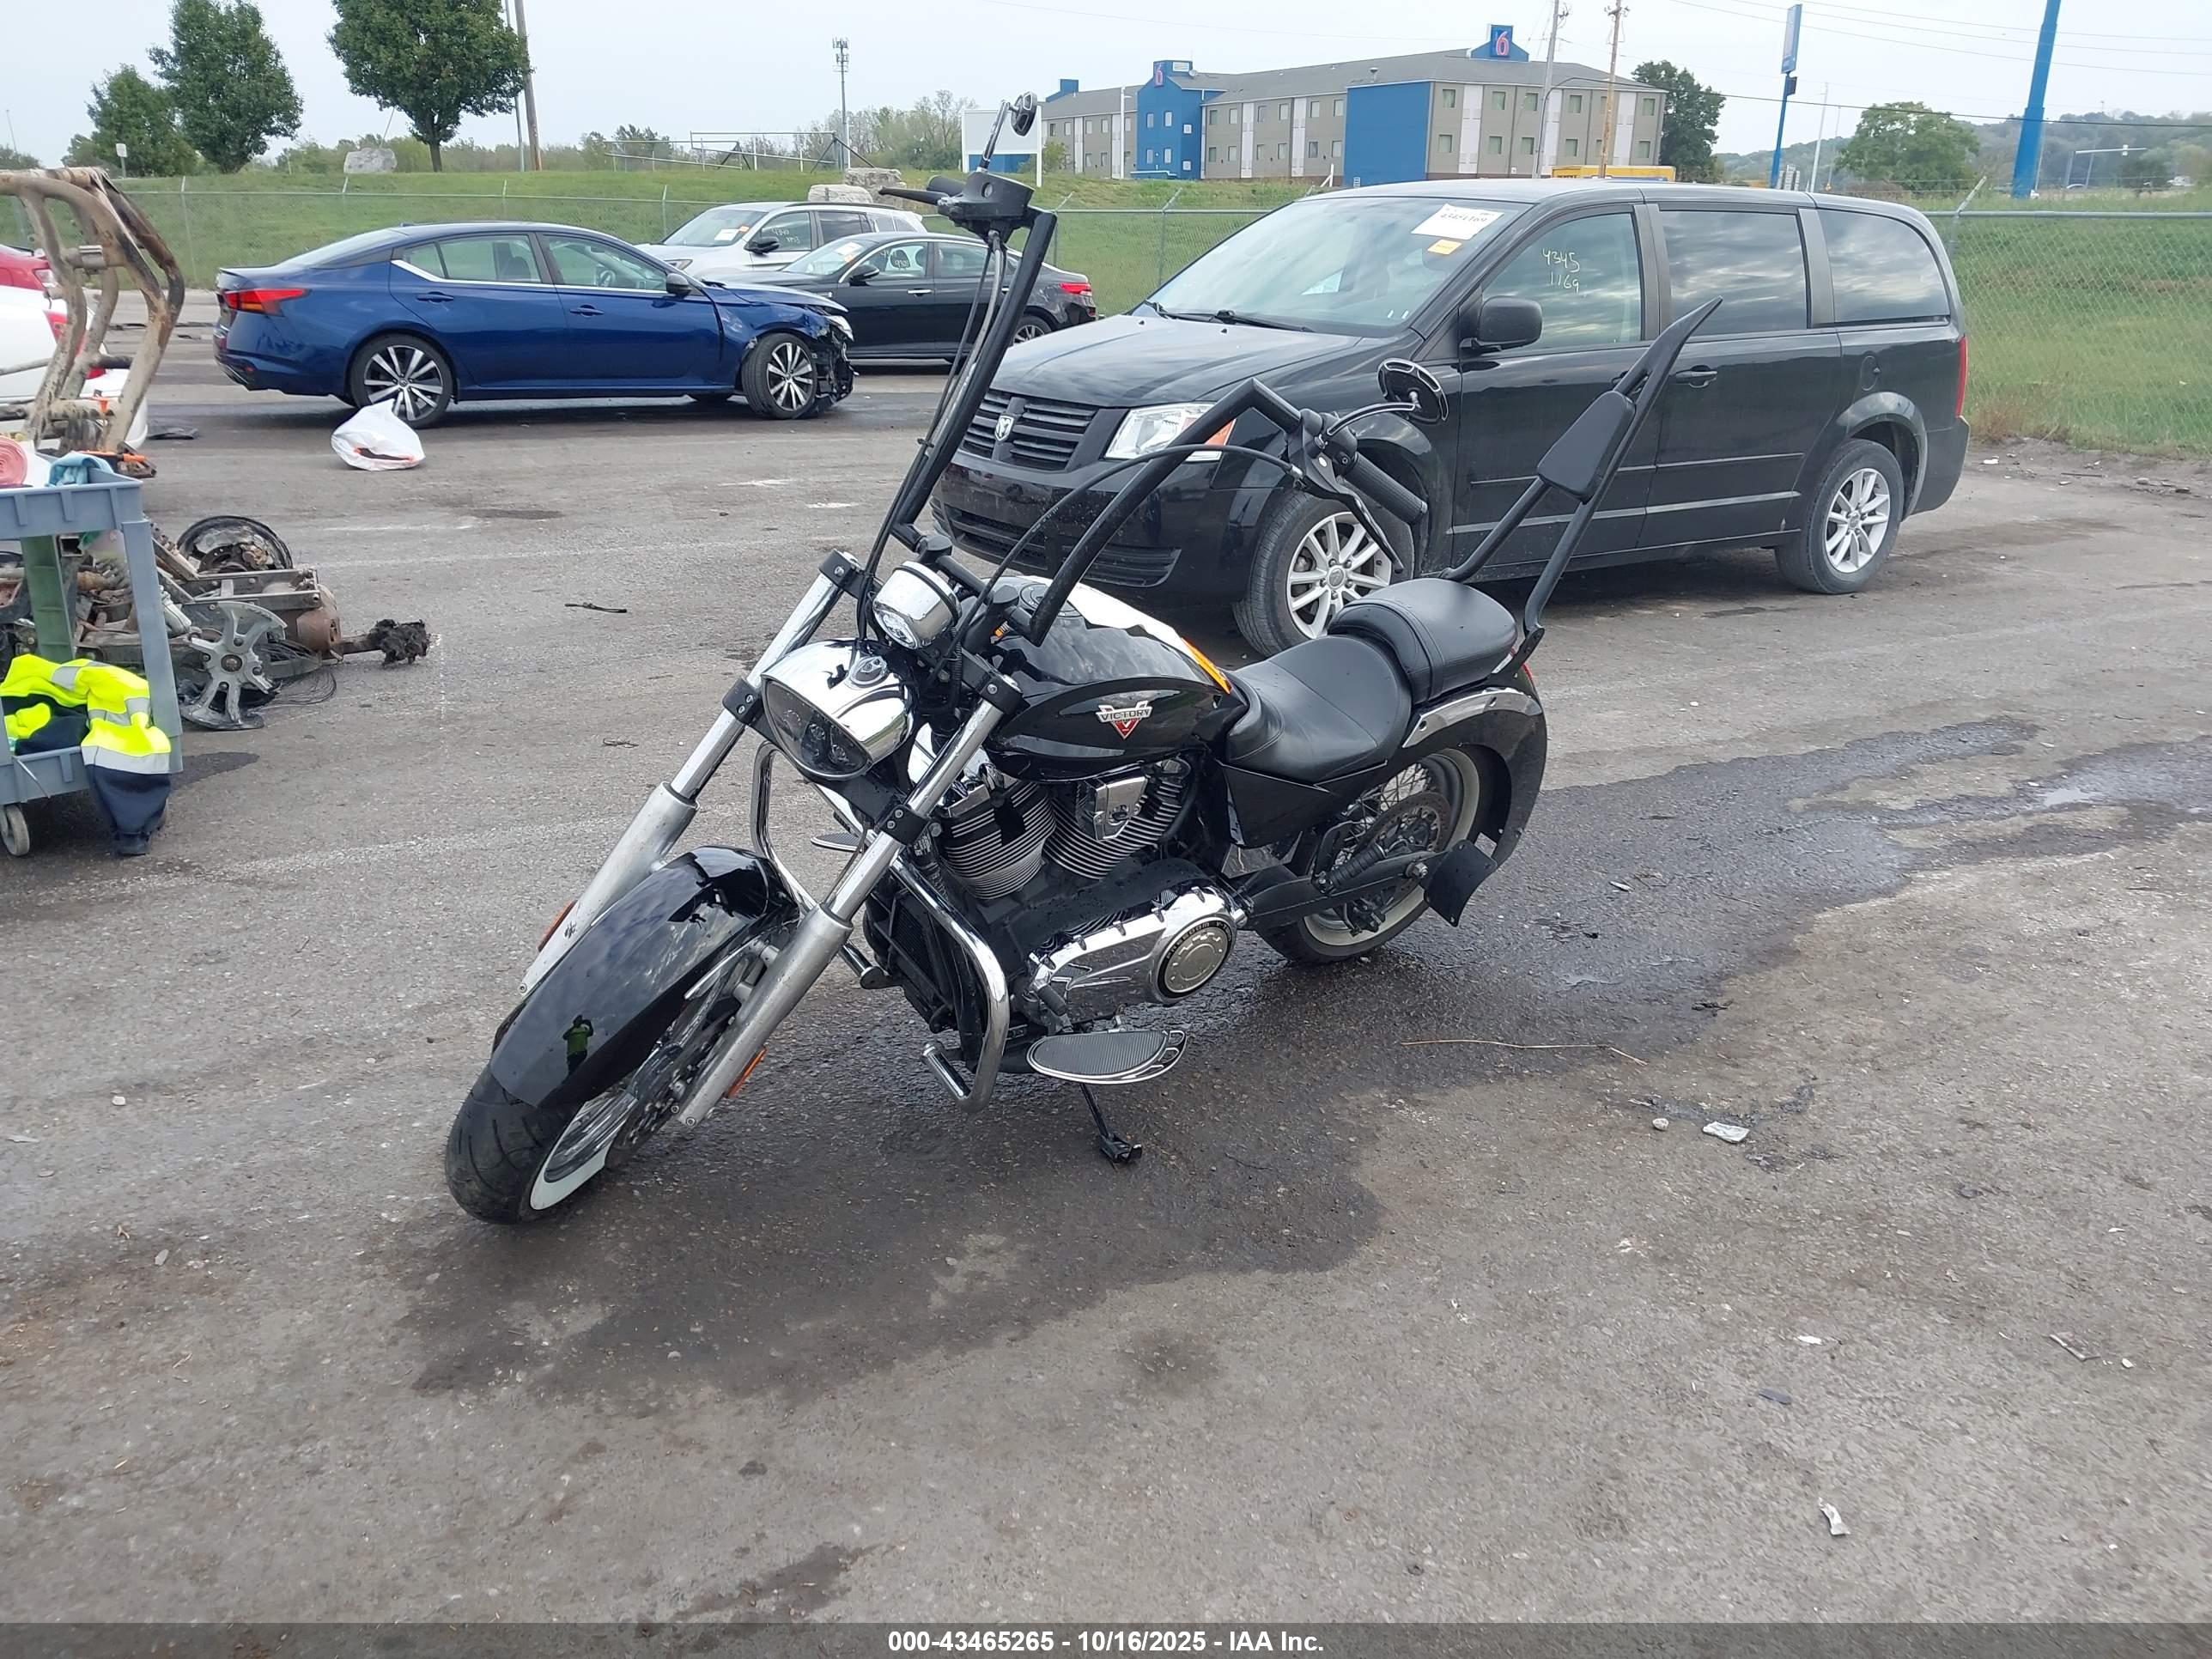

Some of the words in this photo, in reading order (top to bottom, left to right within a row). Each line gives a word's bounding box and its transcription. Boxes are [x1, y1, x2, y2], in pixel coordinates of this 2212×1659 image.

[1496, 31, 1510, 56] 6
[1154, 64, 1164, 86] 6
[1541, 248, 1580, 273] 4345
[1550, 271, 1580, 294] 1169
[1100, 708, 1150, 721] VICTORY
